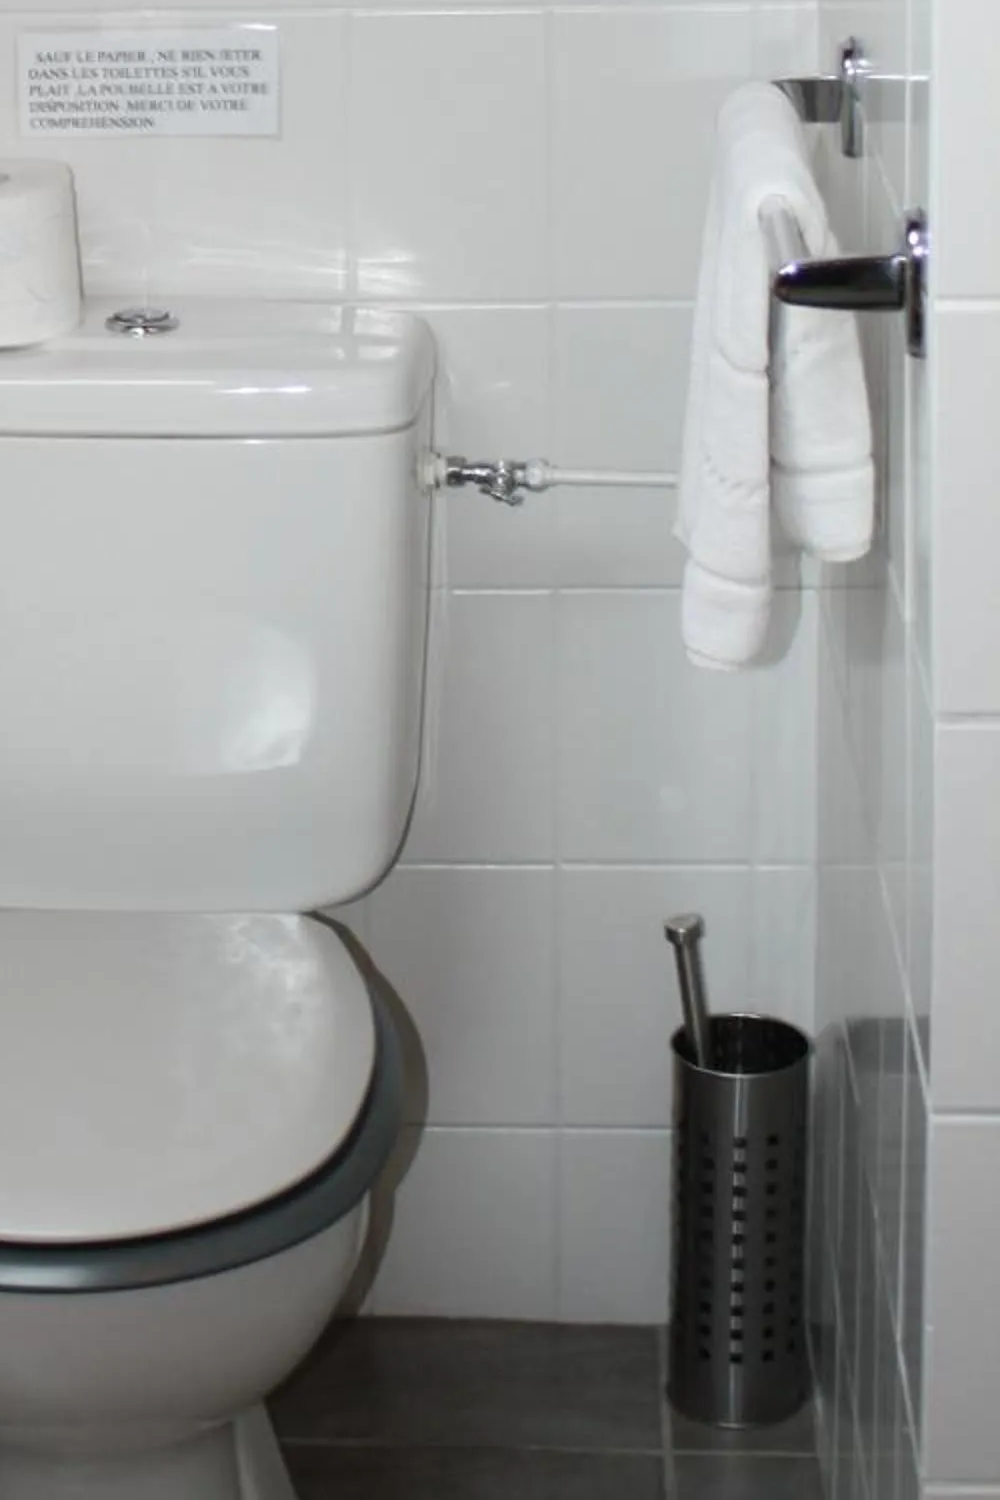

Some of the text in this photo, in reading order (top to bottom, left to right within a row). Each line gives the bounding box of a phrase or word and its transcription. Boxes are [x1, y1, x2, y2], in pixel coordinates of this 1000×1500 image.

[36, 50, 72, 62] SAUF
[76, 50, 96, 62] LE
[97, 50, 145, 62] PAPIER
[157, 50, 176, 62] NE
[181, 49, 216, 62] RIEN
[219, 49, 262, 62] JETER
[28, 67, 68, 80] DANS
[71, 67, 99, 79] LES
[101, 67, 179, 79] TOILETTES
[209, 66, 250, 78] VOUS
[99, 83, 173, 96] POUBELLE
[178, 83, 203, 95] EST
[219, 83, 268, 95] VOTRE
[127, 100, 174, 112] MERCI
[176, 99, 195, 111] DE
[200, 99, 249, 111] VOTRE
